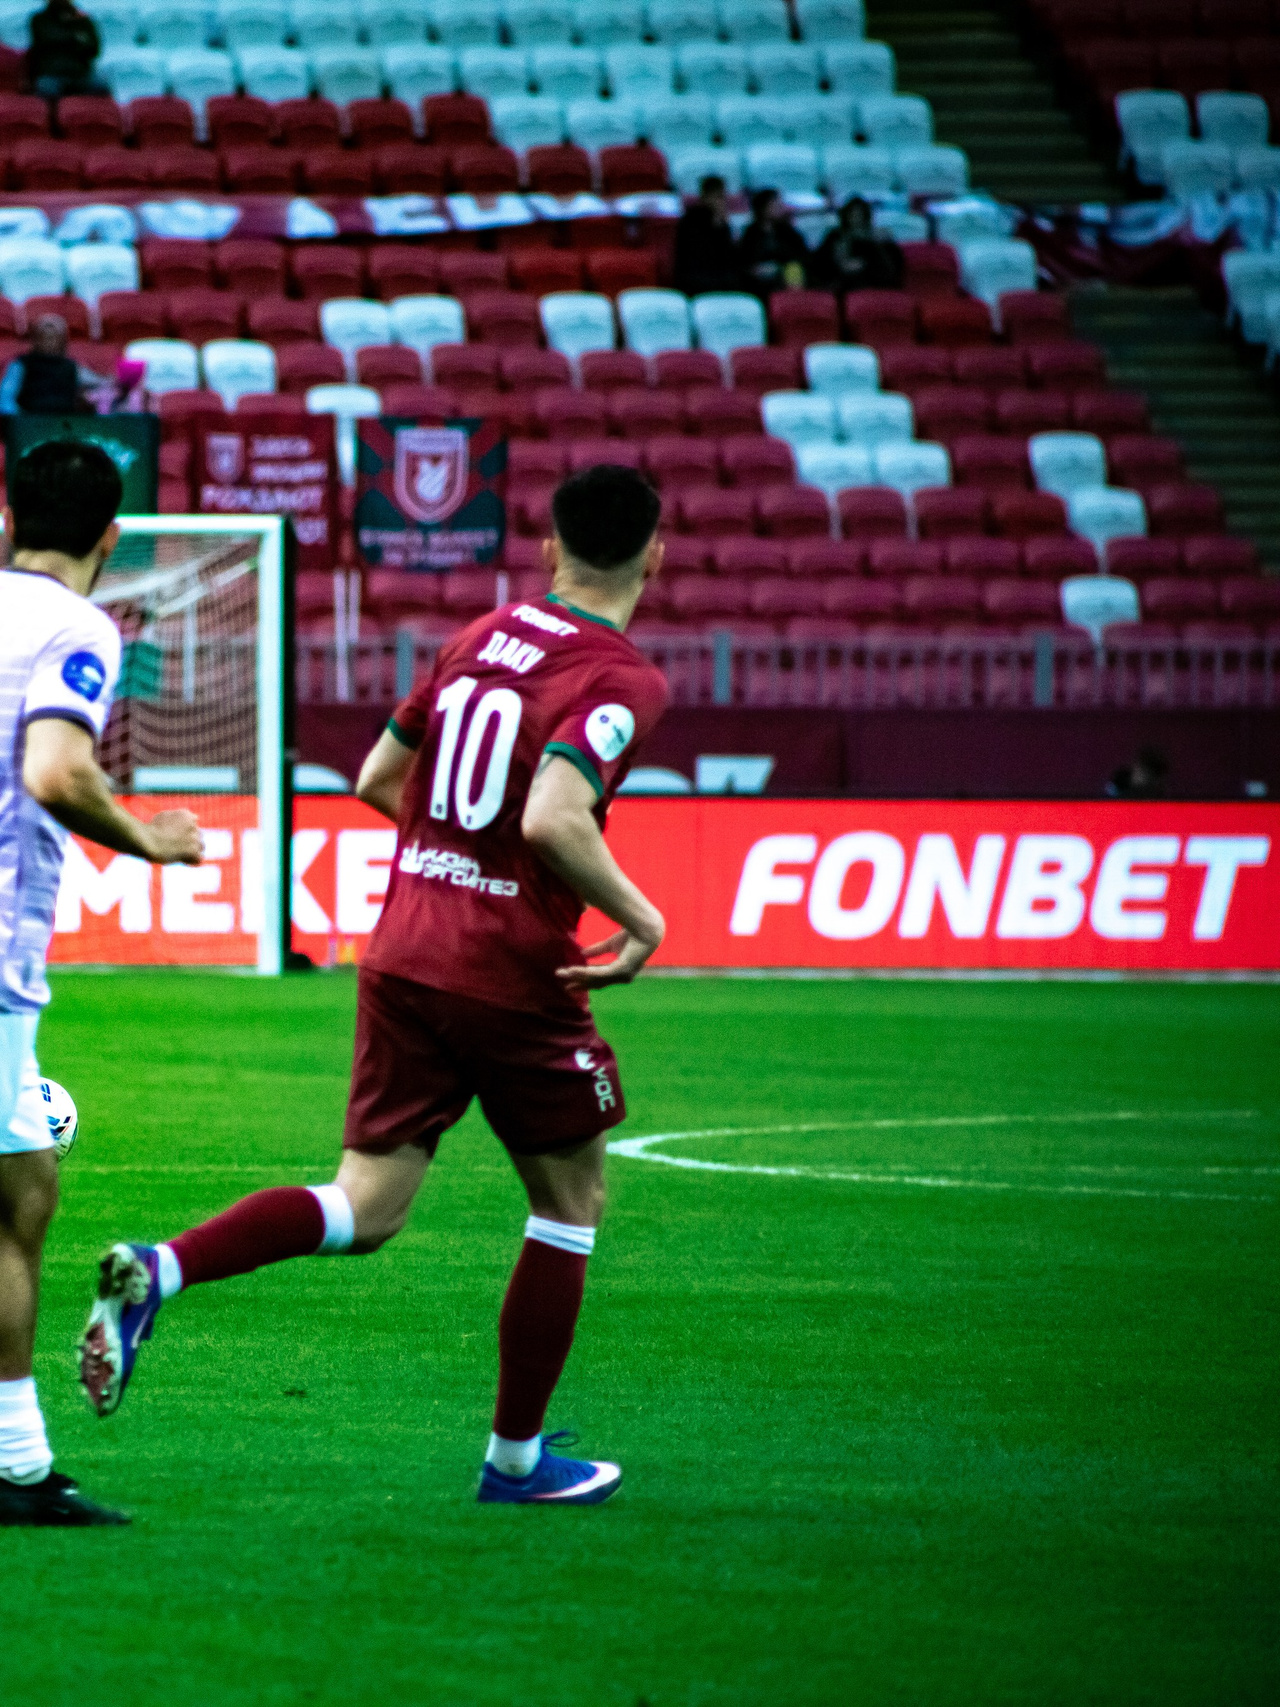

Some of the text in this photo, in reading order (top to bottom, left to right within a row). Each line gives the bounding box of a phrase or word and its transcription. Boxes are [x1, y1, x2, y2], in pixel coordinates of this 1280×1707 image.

[477, 630, 545, 674] ДАКУ
[430, 675, 522, 831] 10
[728, 830, 1270, 941] FONBET
